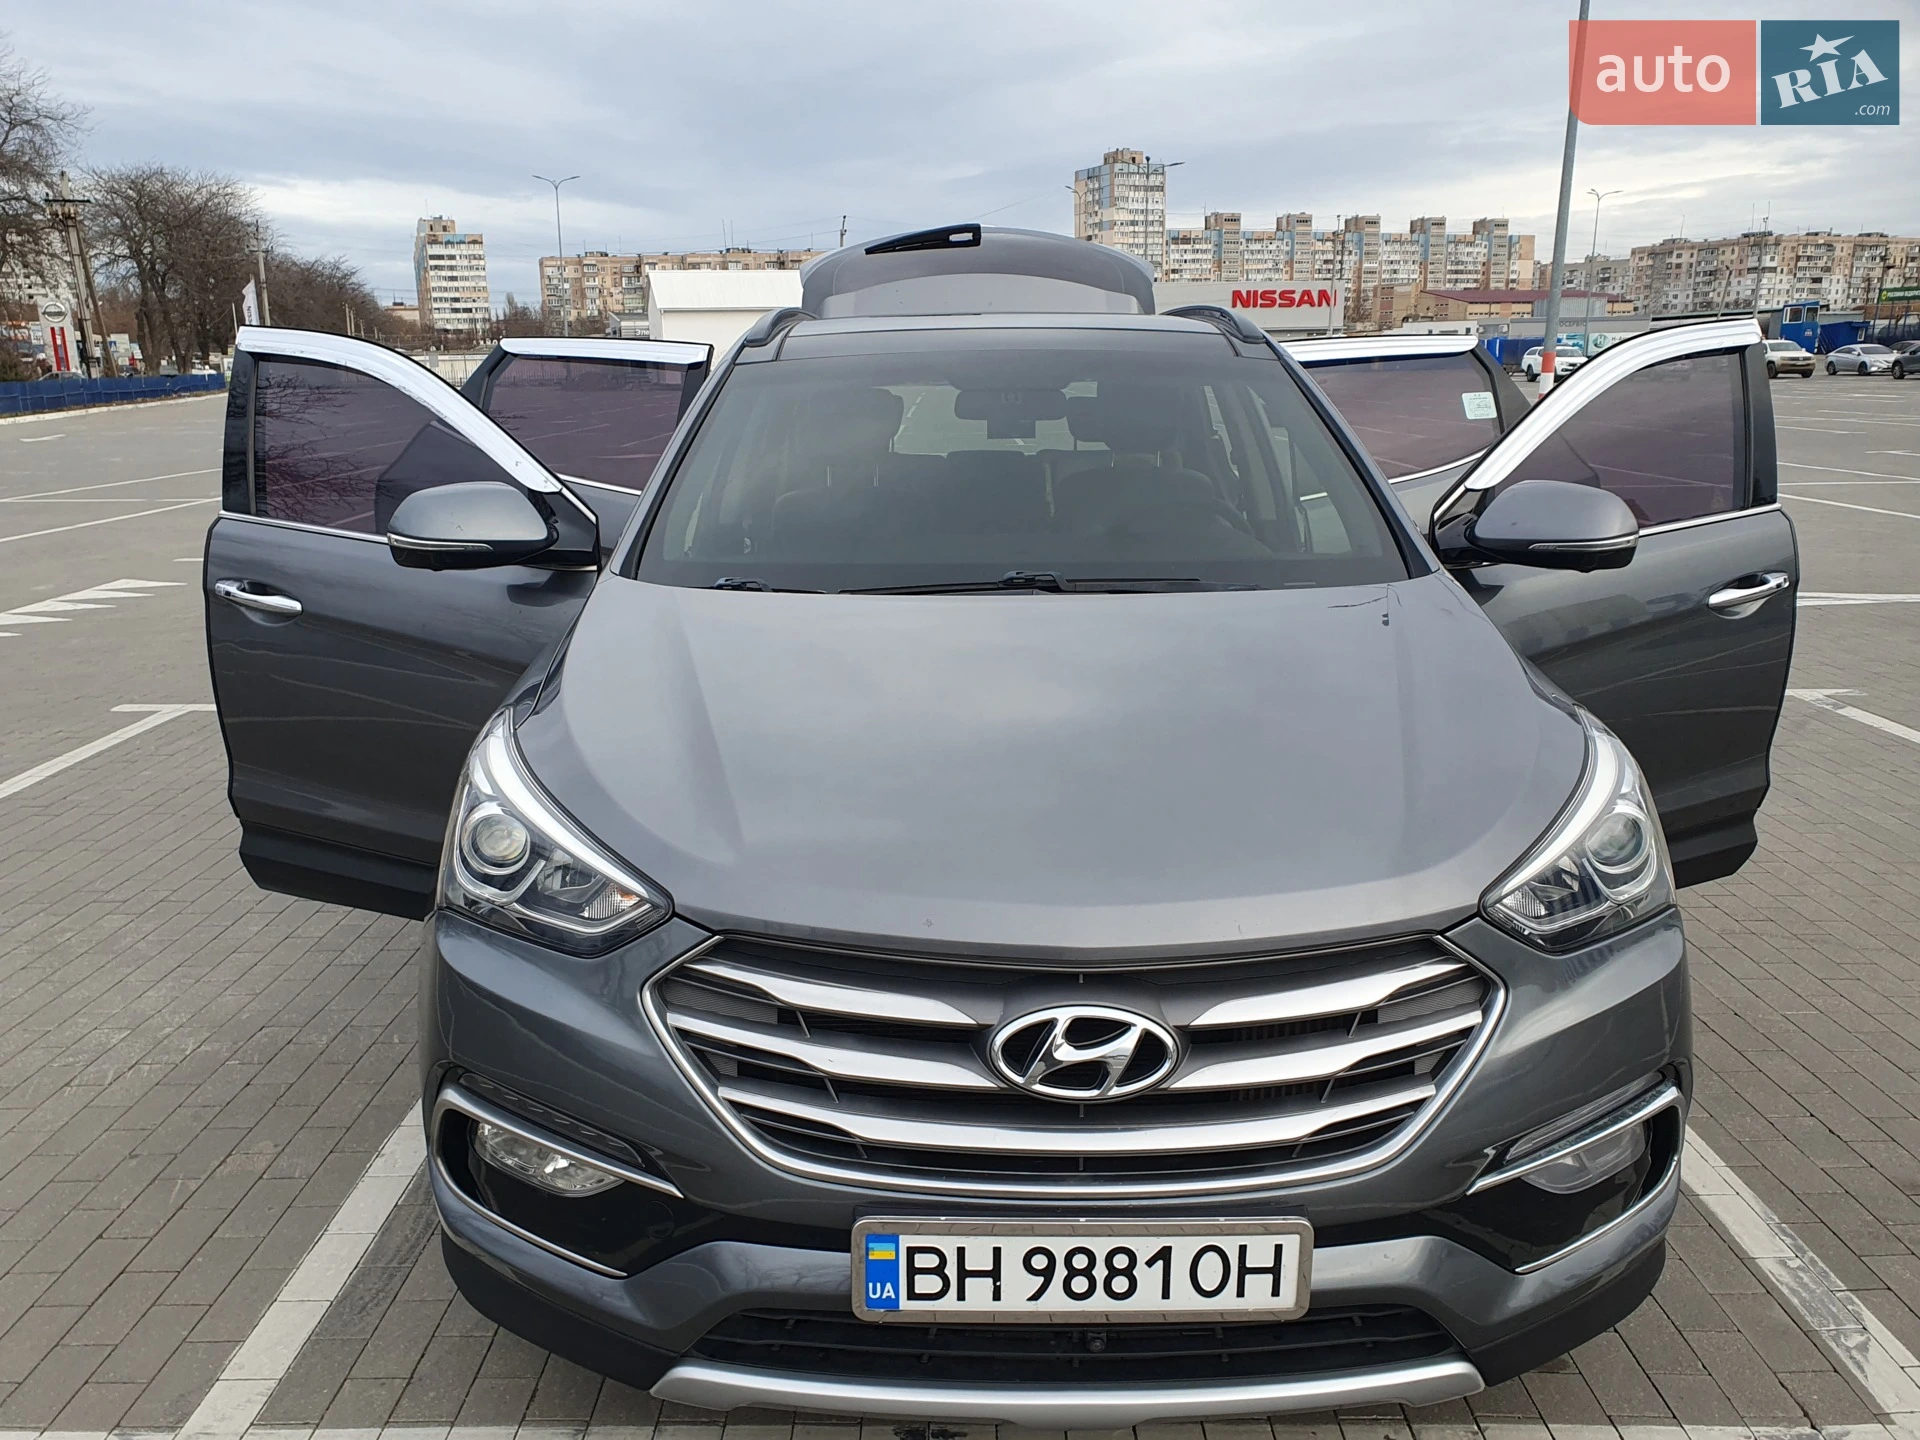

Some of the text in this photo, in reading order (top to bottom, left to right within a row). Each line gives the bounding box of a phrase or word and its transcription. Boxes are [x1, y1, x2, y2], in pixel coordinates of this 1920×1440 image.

[1231, 288, 1337, 309] NISSAN
[905, 1242, 1284, 1302] BH 9881 OH
[867, 1281, 896, 1300] UA
